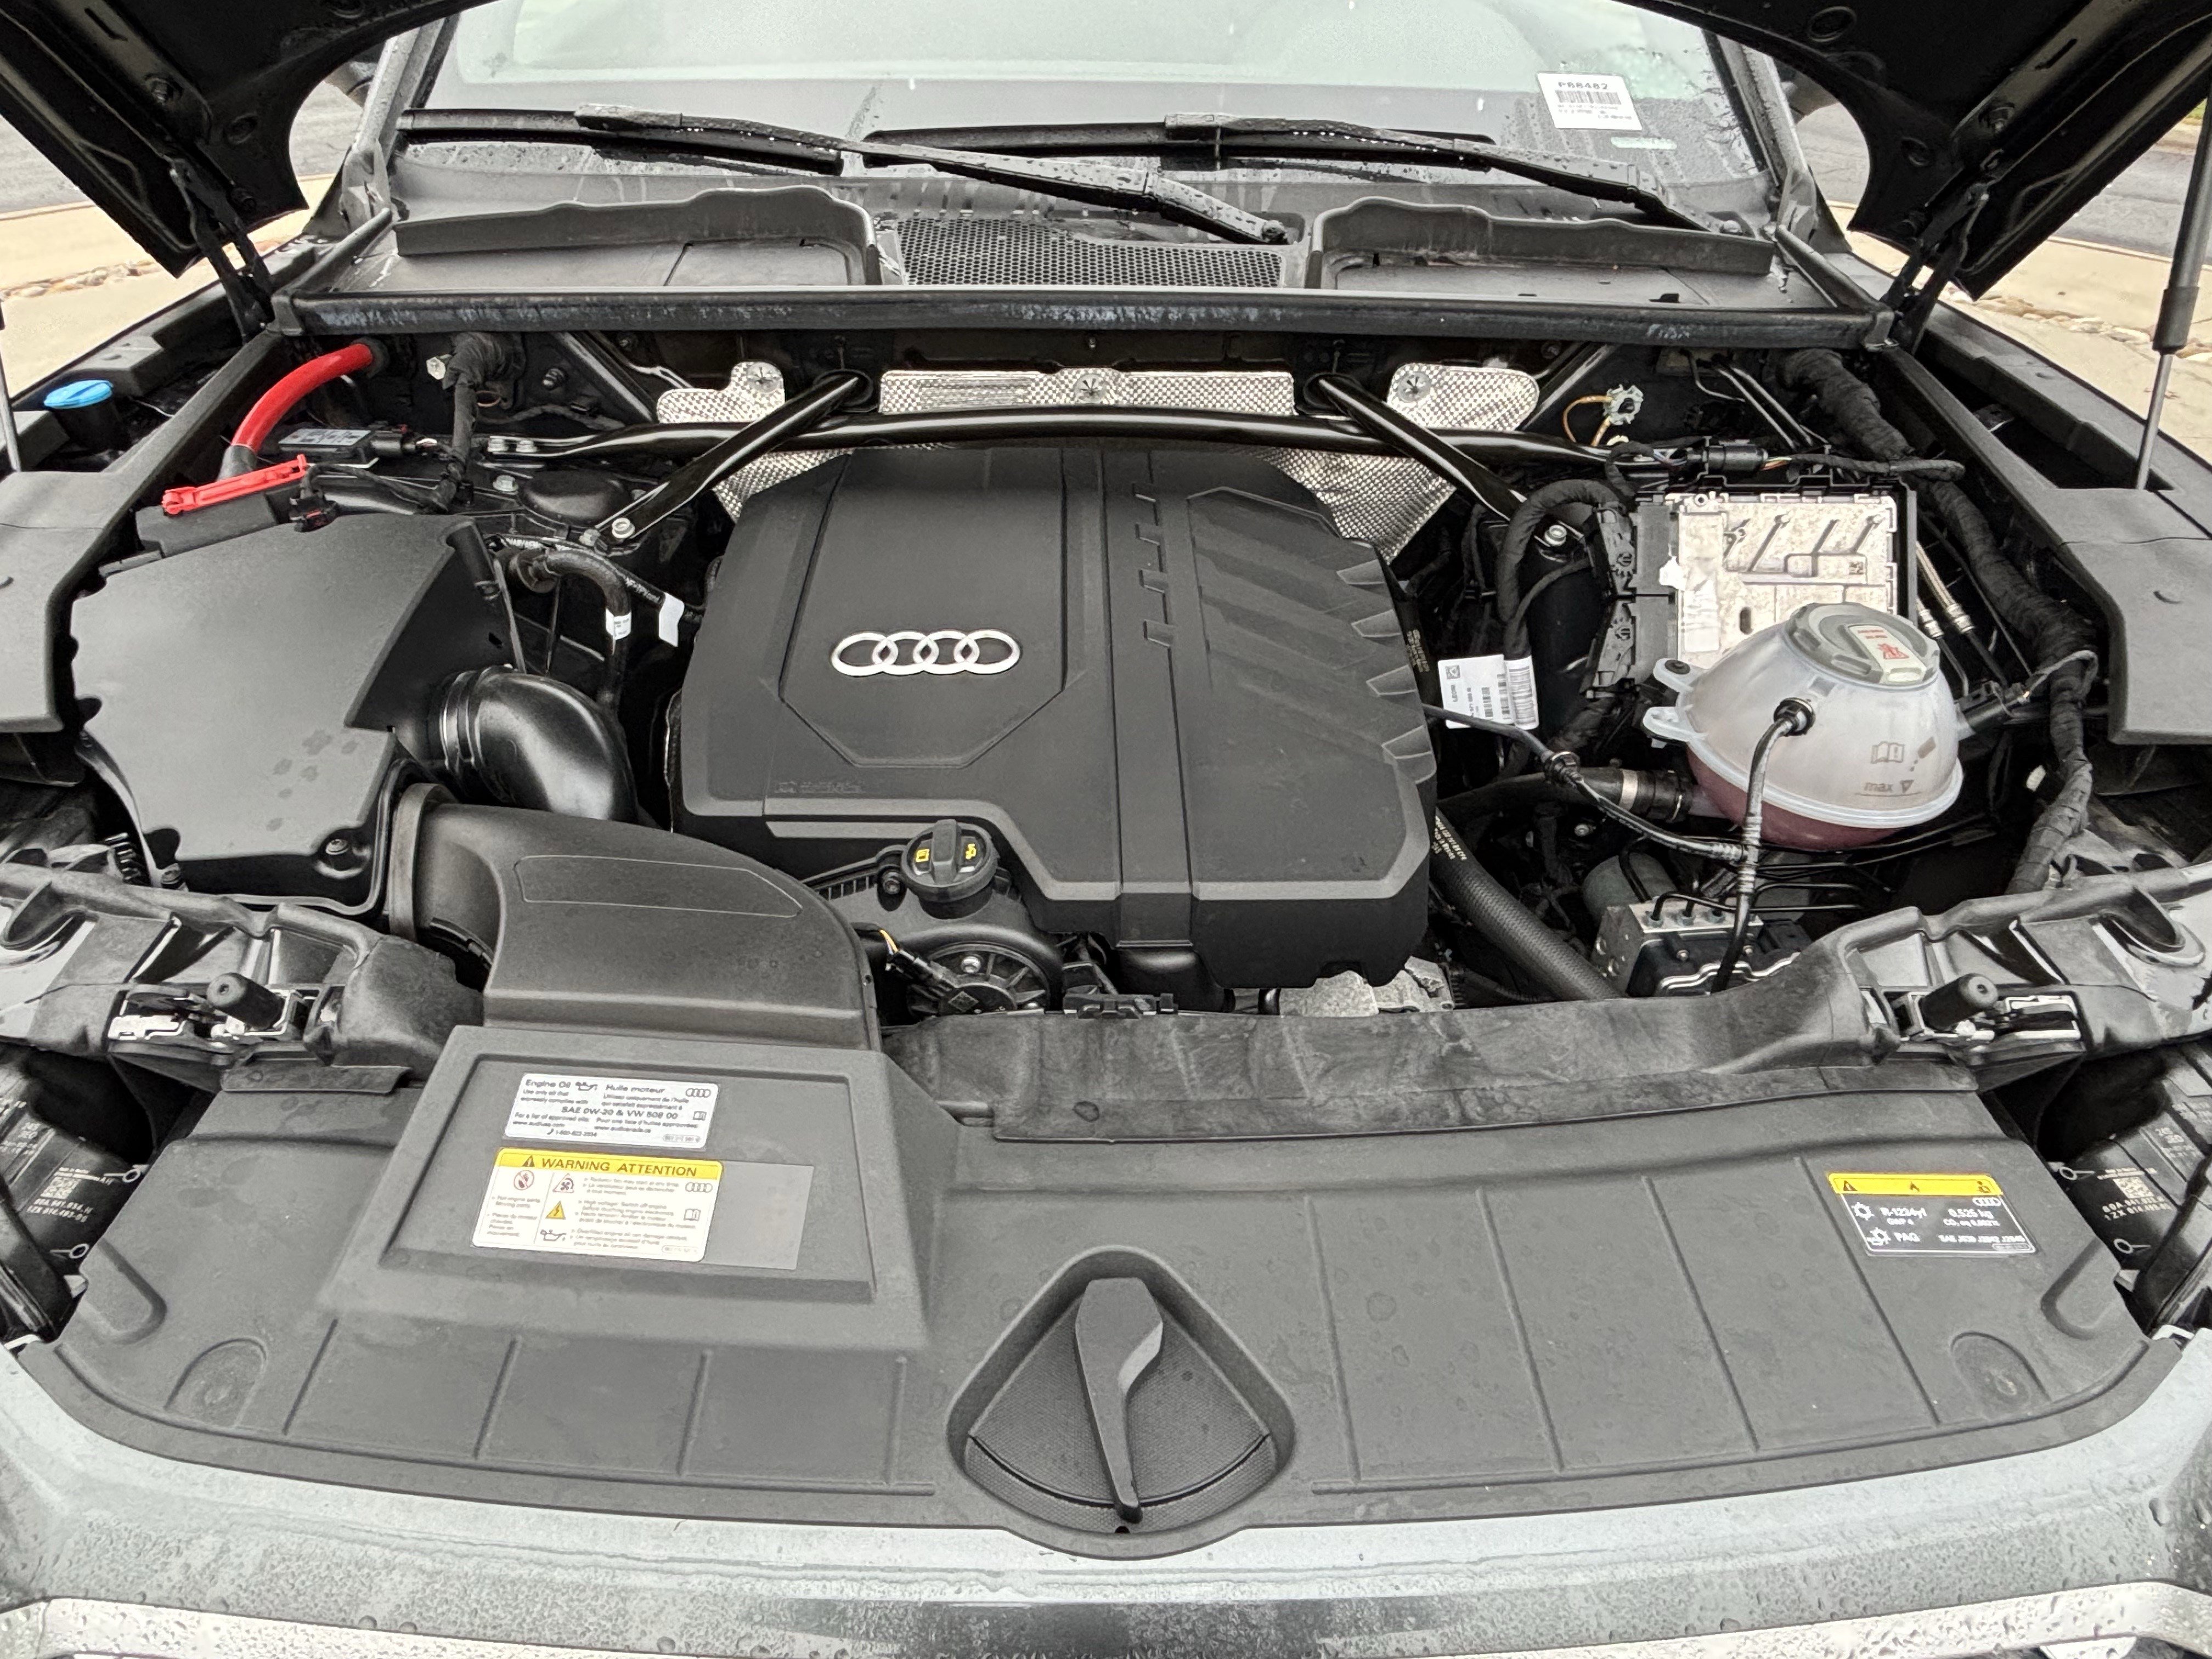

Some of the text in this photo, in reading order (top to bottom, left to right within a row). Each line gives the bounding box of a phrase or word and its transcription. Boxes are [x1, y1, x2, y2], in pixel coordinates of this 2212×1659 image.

[1864, 782, 1894, 792] max
[525, 1079, 556, 1088] Engine
[541, 1158, 697, 1177] WARNING ATTENTION
[1893, 1232, 1921, 1242] PAG
